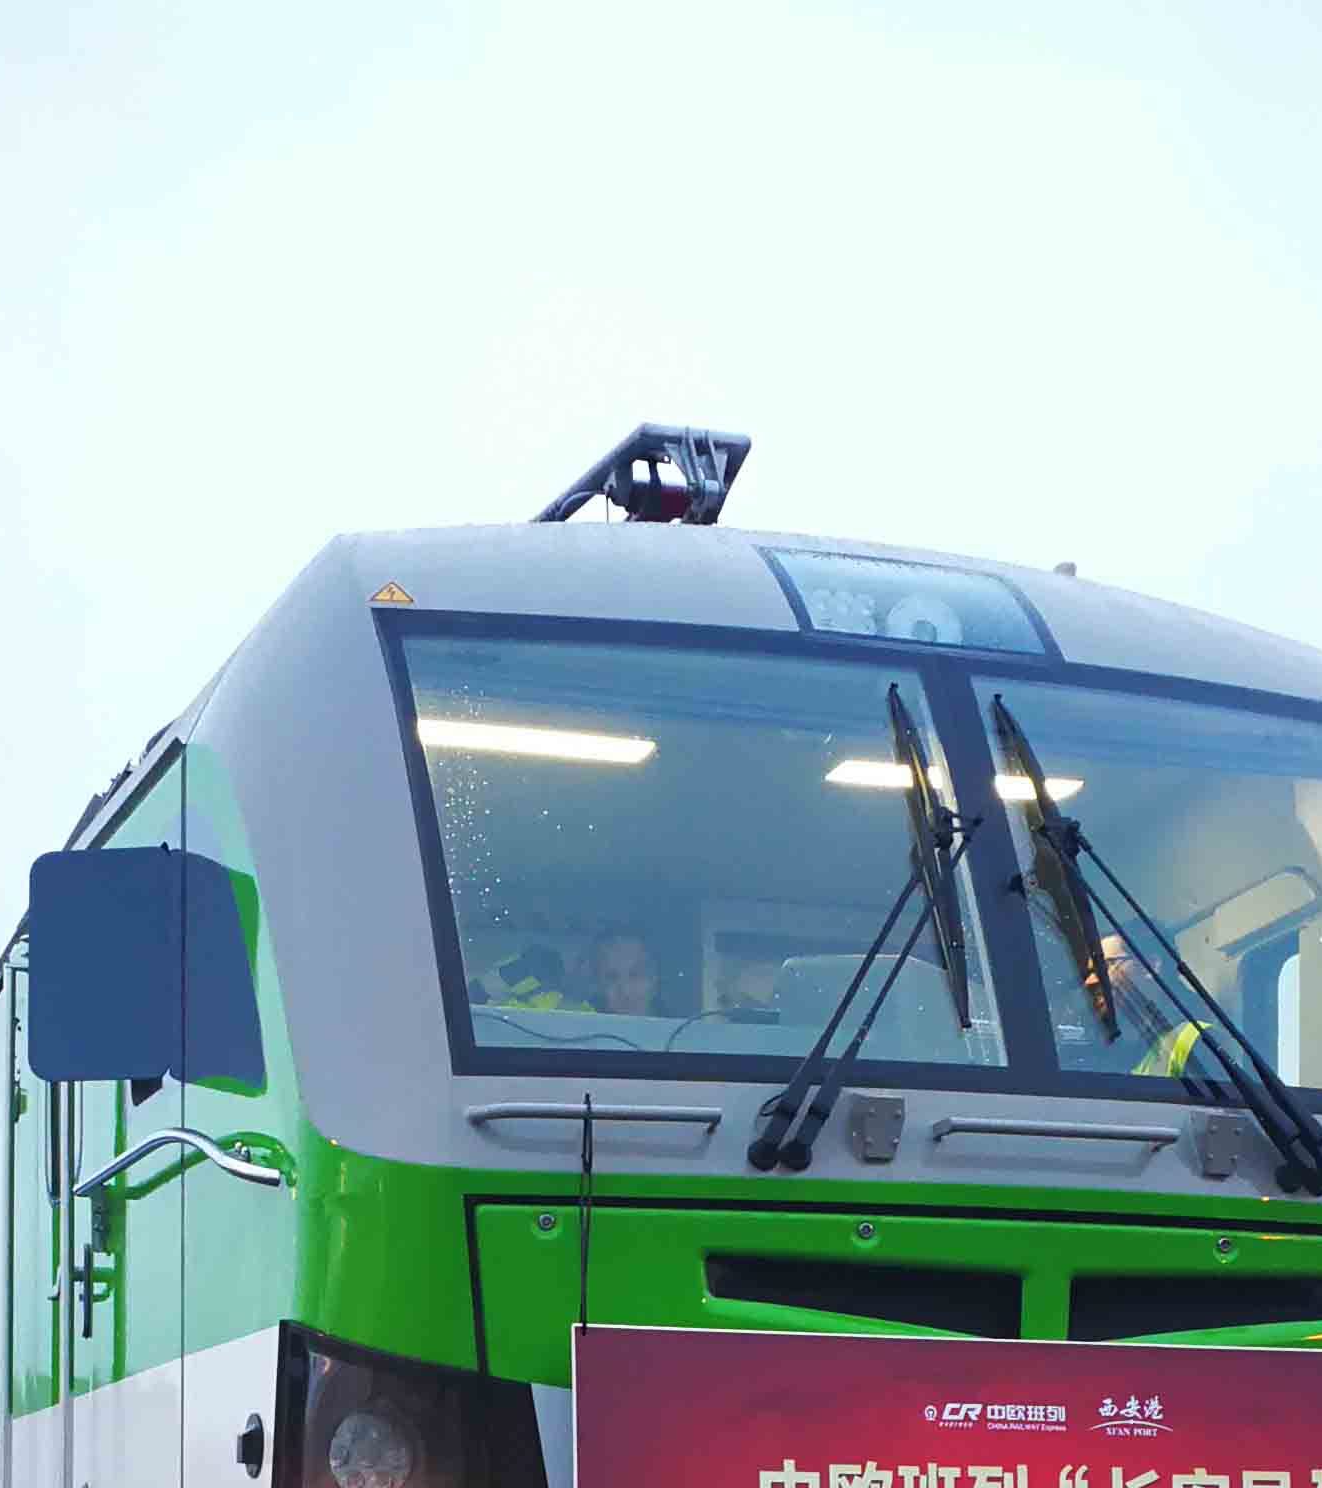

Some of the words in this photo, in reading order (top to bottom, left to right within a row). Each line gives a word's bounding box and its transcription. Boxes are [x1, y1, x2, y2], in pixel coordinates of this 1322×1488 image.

[941, 1403, 983, 1421] CR
[986, 1404, 1067, 1423] 中欧班列
